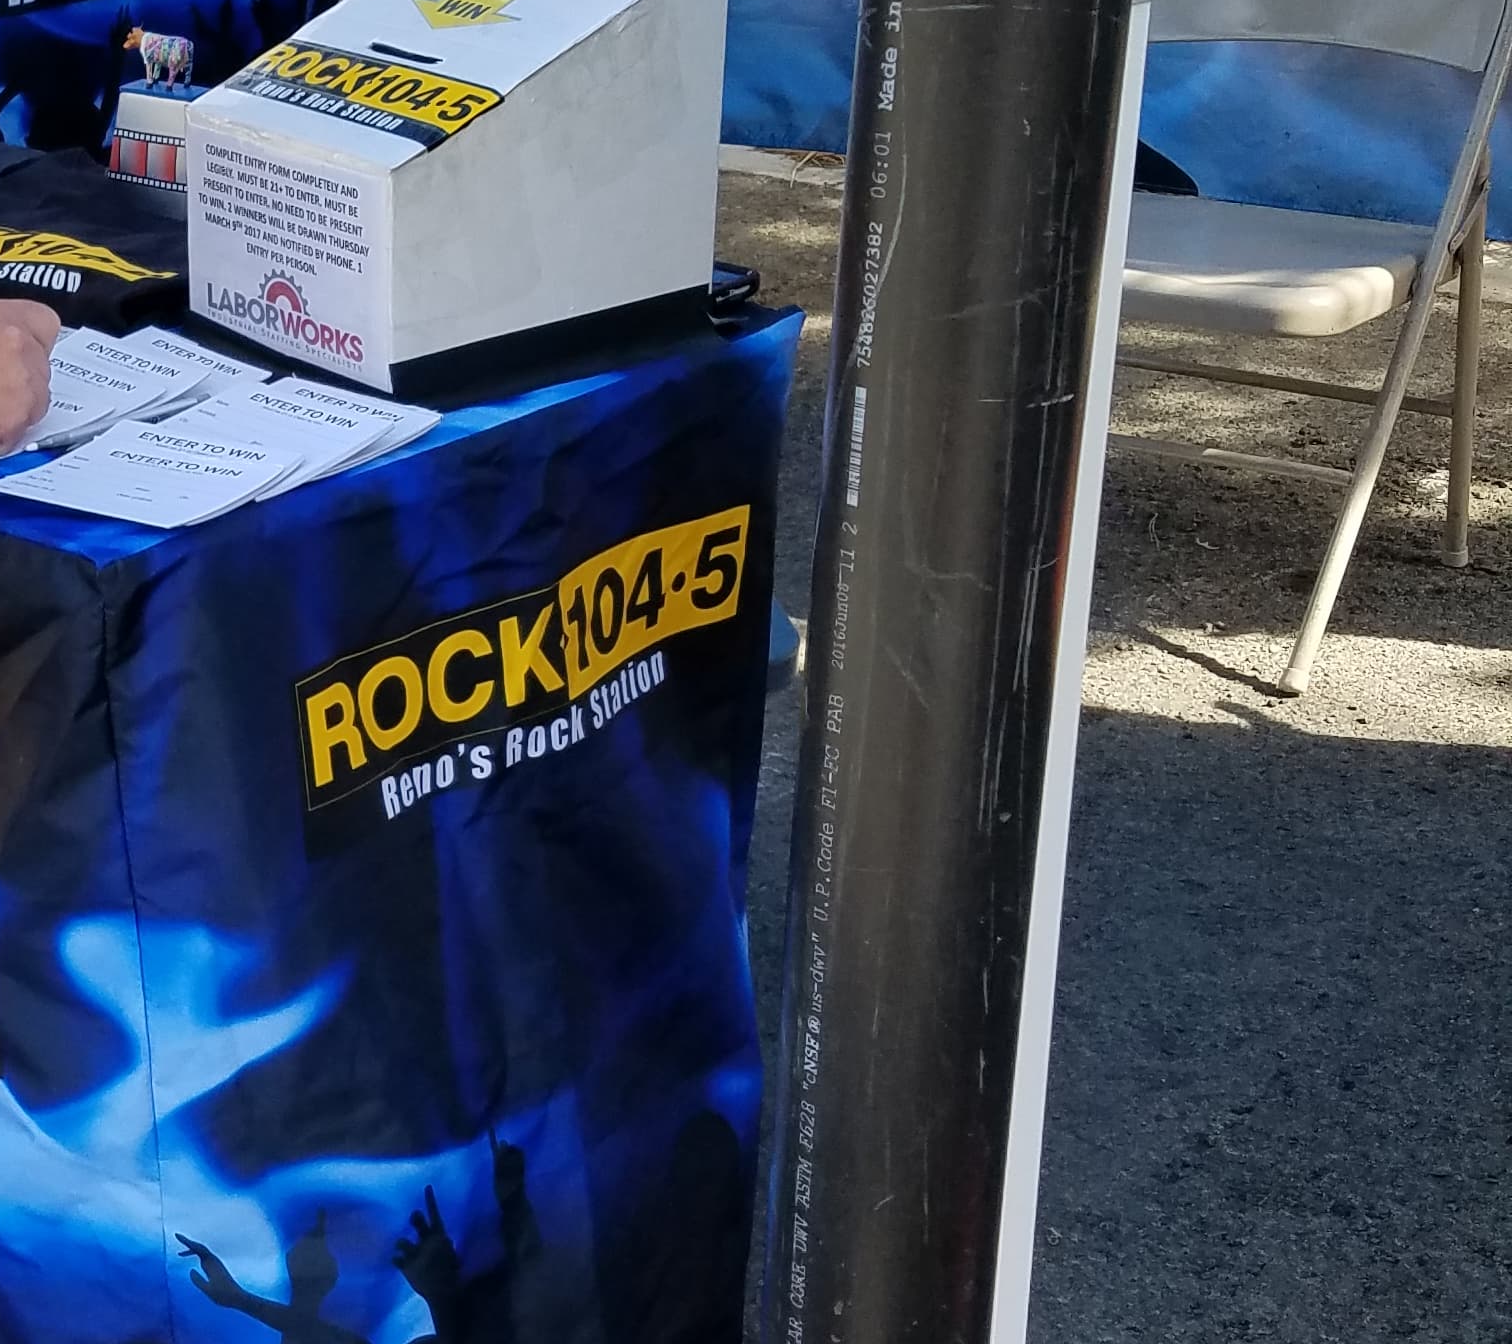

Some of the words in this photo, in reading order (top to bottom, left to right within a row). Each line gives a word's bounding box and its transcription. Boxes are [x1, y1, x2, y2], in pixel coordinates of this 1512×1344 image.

[884, 1, 902, 32] in
[252, 43, 380, 98] ROCK
[878, 47, 899, 113] Made
[252, 80, 306, 102] Reno's
[301, 90, 345, 115] Rock
[339, 101, 406, 132] Station
[205, 143, 243, 165] COMPLETE
[244, 154, 267, 172] ENTRY
[268, 159, 291, 180] FORM
[291, 169, 339, 194] COMPLETELY
[340, 183, 359, 200] AND
[206, 161, 235, 180] LEGIBLY.
[237, 170, 258, 187] MUST
[259, 176, 269, 190] BE
[270, 179, 284, 194] 21+
[285, 185, 296, 199] TO
[296, 189, 323, 208] ENTER.
[324, 197, 347, 216] MUST
[348, 205, 360, 219] BE
[869, 131, 893, 199] 06:01
[198, 192, 208, 206] TO
[209, 196, 227, 211] WIN.
[227, 201, 234, 214] 2
[234, 204, 267, 225] WINNERS
[268, 214, 285, 232] WILL
[287, 221, 297, 236] BE
[297, 225, 327, 245] DRAWN
[328, 234, 371, 258] THURSDAY
[203, 176, 234, 197] PRESENT
[235, 187, 245, 202] TO
[245, 190, 270, 208] ENTER.
[271, 199, 284, 214] NO
[285, 203, 305, 220] NEED
[306, 209, 317, 223] TO
[317, 213, 328, 228] BE
[329, 216, 364, 239] PRESENT
[204, 212, 231, 229] MARCH
[244, 224, 262, 241] 2017
[262, 231, 279, 246] AND
[280, 235, 314, 258] NOTIFIED
[315, 247, 325, 261] BY
[326, 251, 356, 272] PHONE.
[357, 260, 363, 274] 1
[246, 243, 269, 260] ENTRY
[270, 250, 285, 265] PER
[285, 256, 318, 276] PERSON.
[207, 282, 364, 363] LABORWORKS
[50, 358, 90, 377] ENTER
[90, 372, 108, 383] TO
[108, 377, 136, 392] WIN
[86, 342, 133, 363] ENTER
[133, 357, 151, 368] TO
[151, 363, 181, 378] WIN
[152, 339, 196, 361] ENTER
[197, 355, 215, 366] TO
[213, 360, 242, 376] WIN
[250, 393, 305, 414] ENTER
[303, 407, 324, 419] TO
[325, 414, 358, 429] WIN
[295, 387, 348, 407] ENTER
[349, 402, 369, 413] TO
[109, 450, 172, 468] ENTER
[175, 459, 201, 471] TO
[203, 464, 244, 477] WIN
[138, 431, 202, 451] ENTER
[202, 442, 226, 454] TO
[228, 447, 266, 461] WIN
[305, 602, 564, 787] ROCK
[826, 693, 845, 735] PAB
[381, 742, 493, 820] Reno's
[505, 707, 585, 769] Rock
[589, 649, 666, 730] Station
[812, 822, 835, 922] U.P.Code
[794, 1156, 814, 1208] ASTM
[792, 1213, 809, 1253] DWV
[789, 1262, 807, 1309] CORE
